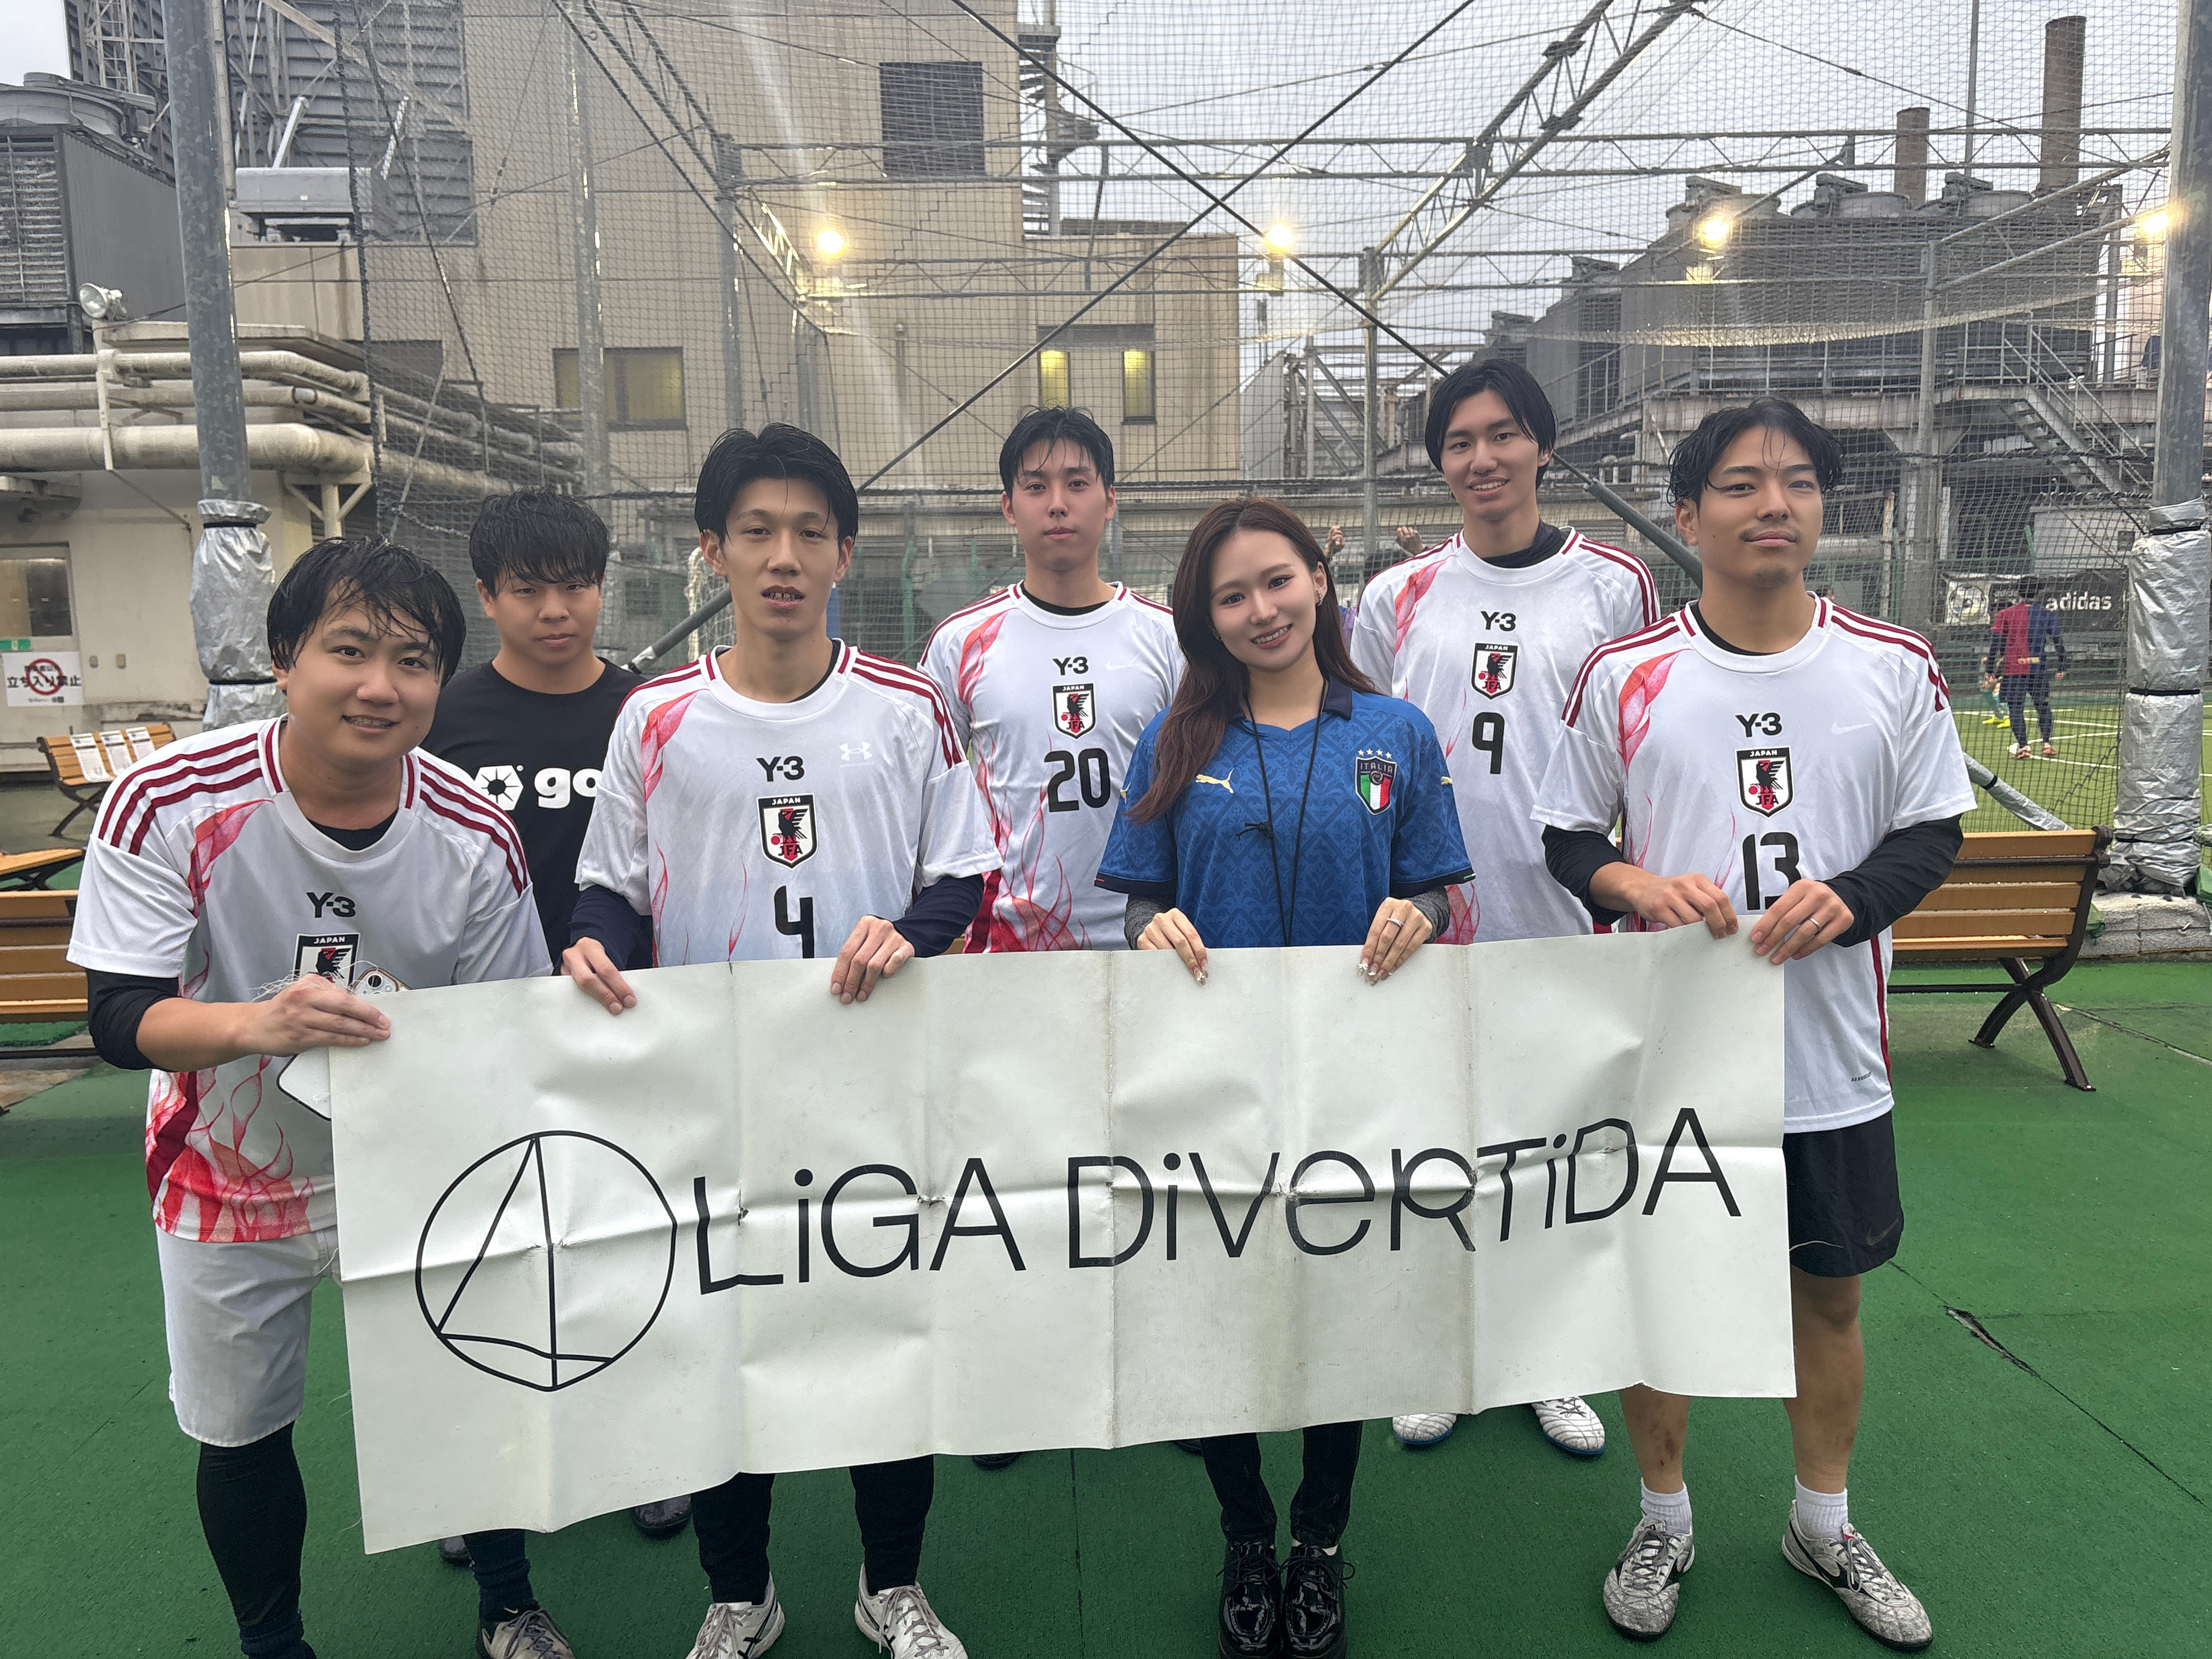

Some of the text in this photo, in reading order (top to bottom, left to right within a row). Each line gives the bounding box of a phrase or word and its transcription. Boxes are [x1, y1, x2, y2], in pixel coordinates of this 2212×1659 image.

[2045, 591, 2113, 611] adidas
[1481, 611, 1516, 631] Y-3
[1053, 656, 1088, 676] Y-3
[1482, 681, 1502, 691] JFA
[1065, 719, 1085, 730] JFA
[1735, 713, 1782, 738] Y-3
[1471, 712, 1505, 775] 9
[757, 756, 805, 781] Y-3
[1360, 763, 1393, 774] ITALIA
[1043, 748, 1111, 812] 20
[771, 797, 802, 805] JAPAN
[1756, 795, 1778, 805] JFA
[778, 844, 803, 856] JFA
[1742, 831, 1802, 911] 13
[306, 892, 356, 918] Y-3
[774, 885, 815, 959] 4
[314, 936, 346, 944] JAPAN
